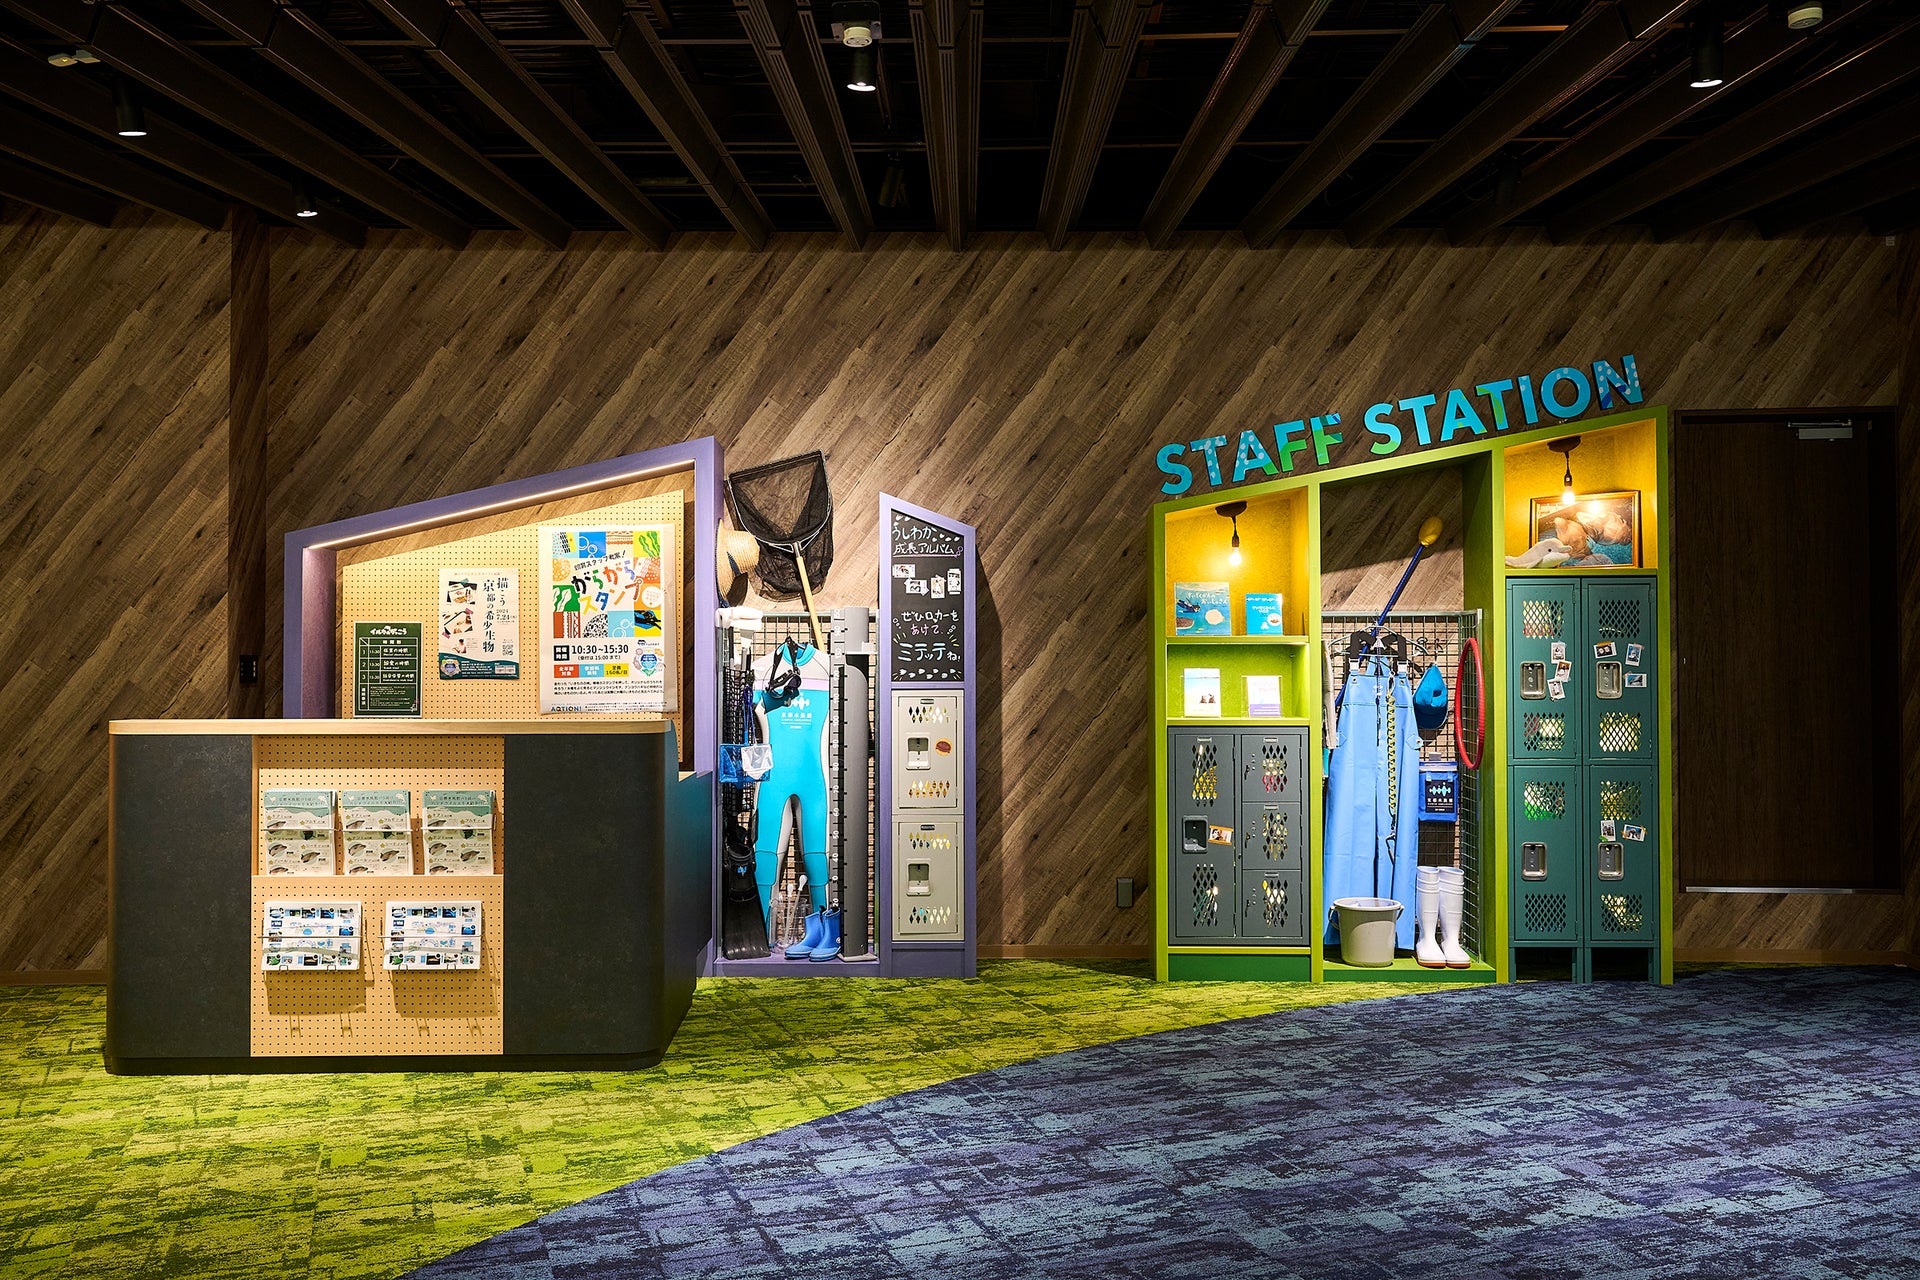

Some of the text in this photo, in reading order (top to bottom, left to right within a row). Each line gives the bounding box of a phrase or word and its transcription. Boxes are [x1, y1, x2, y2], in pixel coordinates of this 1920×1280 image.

[1156, 354, 1645, 495] STAFF STATION
[892, 525, 937, 541] うしわか
[893, 542, 955, 555] 成長アルバム
[571, 560, 635, 594] がらがら
[580, 578, 643, 615] スタンプ
[833, 739, 839, 749] 90
[833, 762, 839, 772] 80
[833, 785, 839, 794] 70
[833, 808, 839, 817] 60
[833, 830, 839, 839] 50
[832, 853, 839, 863] 40
[833, 898, 839, 907] 20
